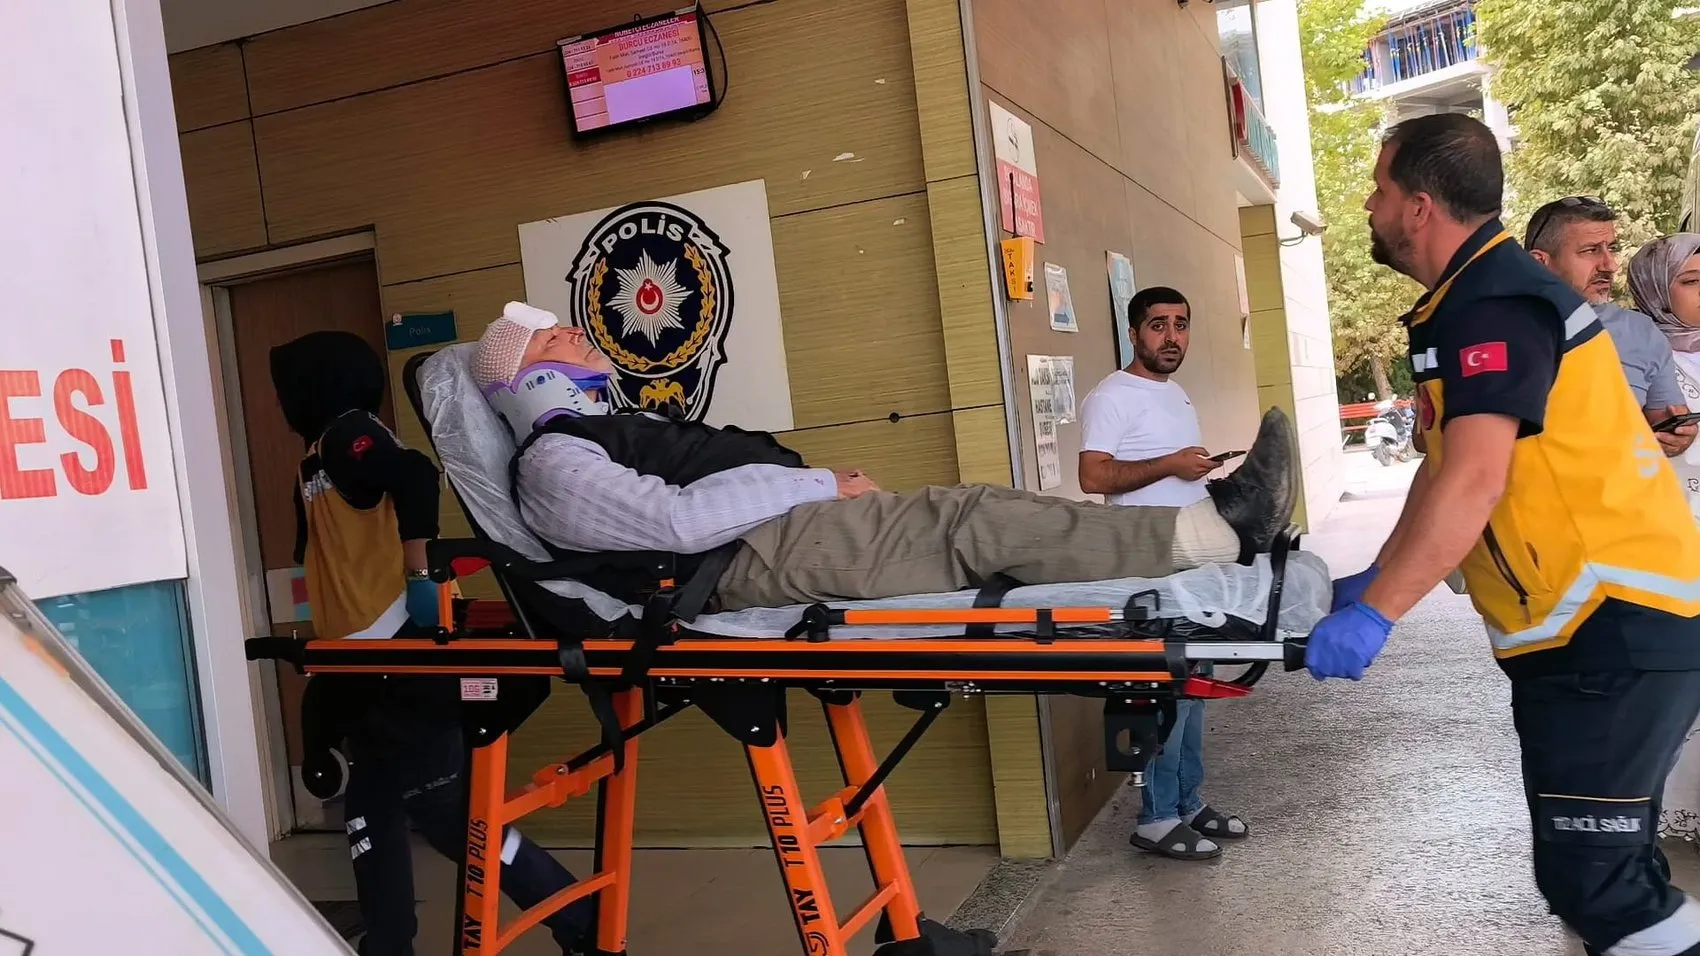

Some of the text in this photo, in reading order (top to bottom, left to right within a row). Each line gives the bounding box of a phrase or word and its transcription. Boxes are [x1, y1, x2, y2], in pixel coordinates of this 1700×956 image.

[633, 66, 646, 76] 224
[601, 214, 685, 254] POLİS
[763, 784, 794, 828] PLUS
[468, 817, 489, 862] PLUS
[793, 888, 821, 926] TAY
[463, 912, 482, 950] TAY
